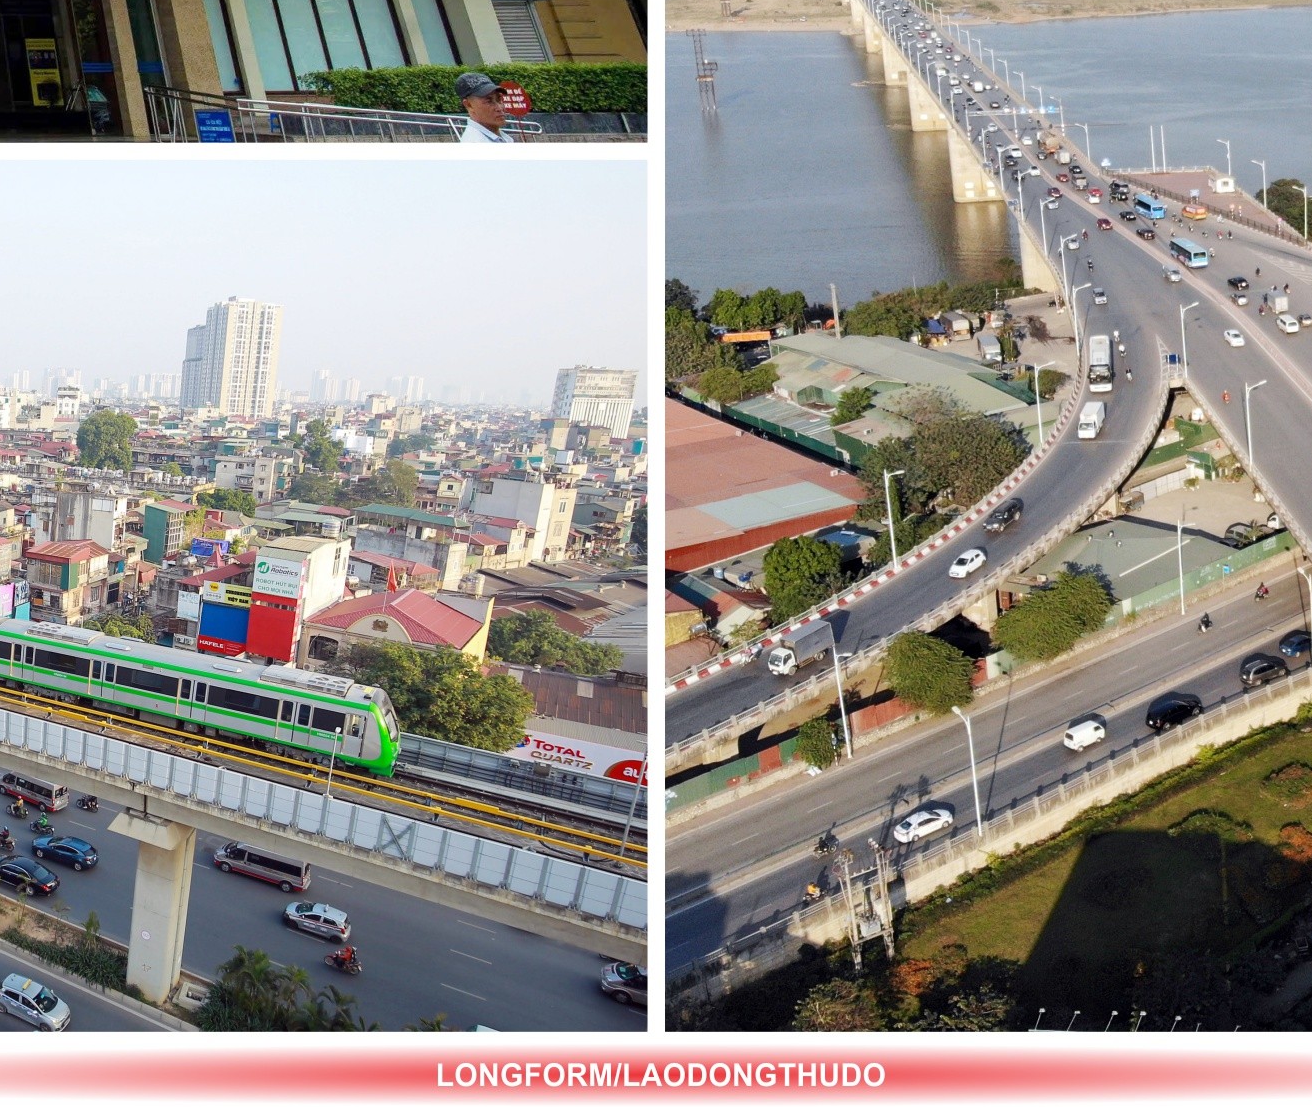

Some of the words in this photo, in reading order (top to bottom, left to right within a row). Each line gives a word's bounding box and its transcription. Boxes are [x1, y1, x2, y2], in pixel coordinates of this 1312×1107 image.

[270, 567, 298, 576] Robotics
[256, 577, 274, 585] ROBOT
[533, 739, 586, 759] TOTAL
[530, 750, 594, 770] QUARTZ
